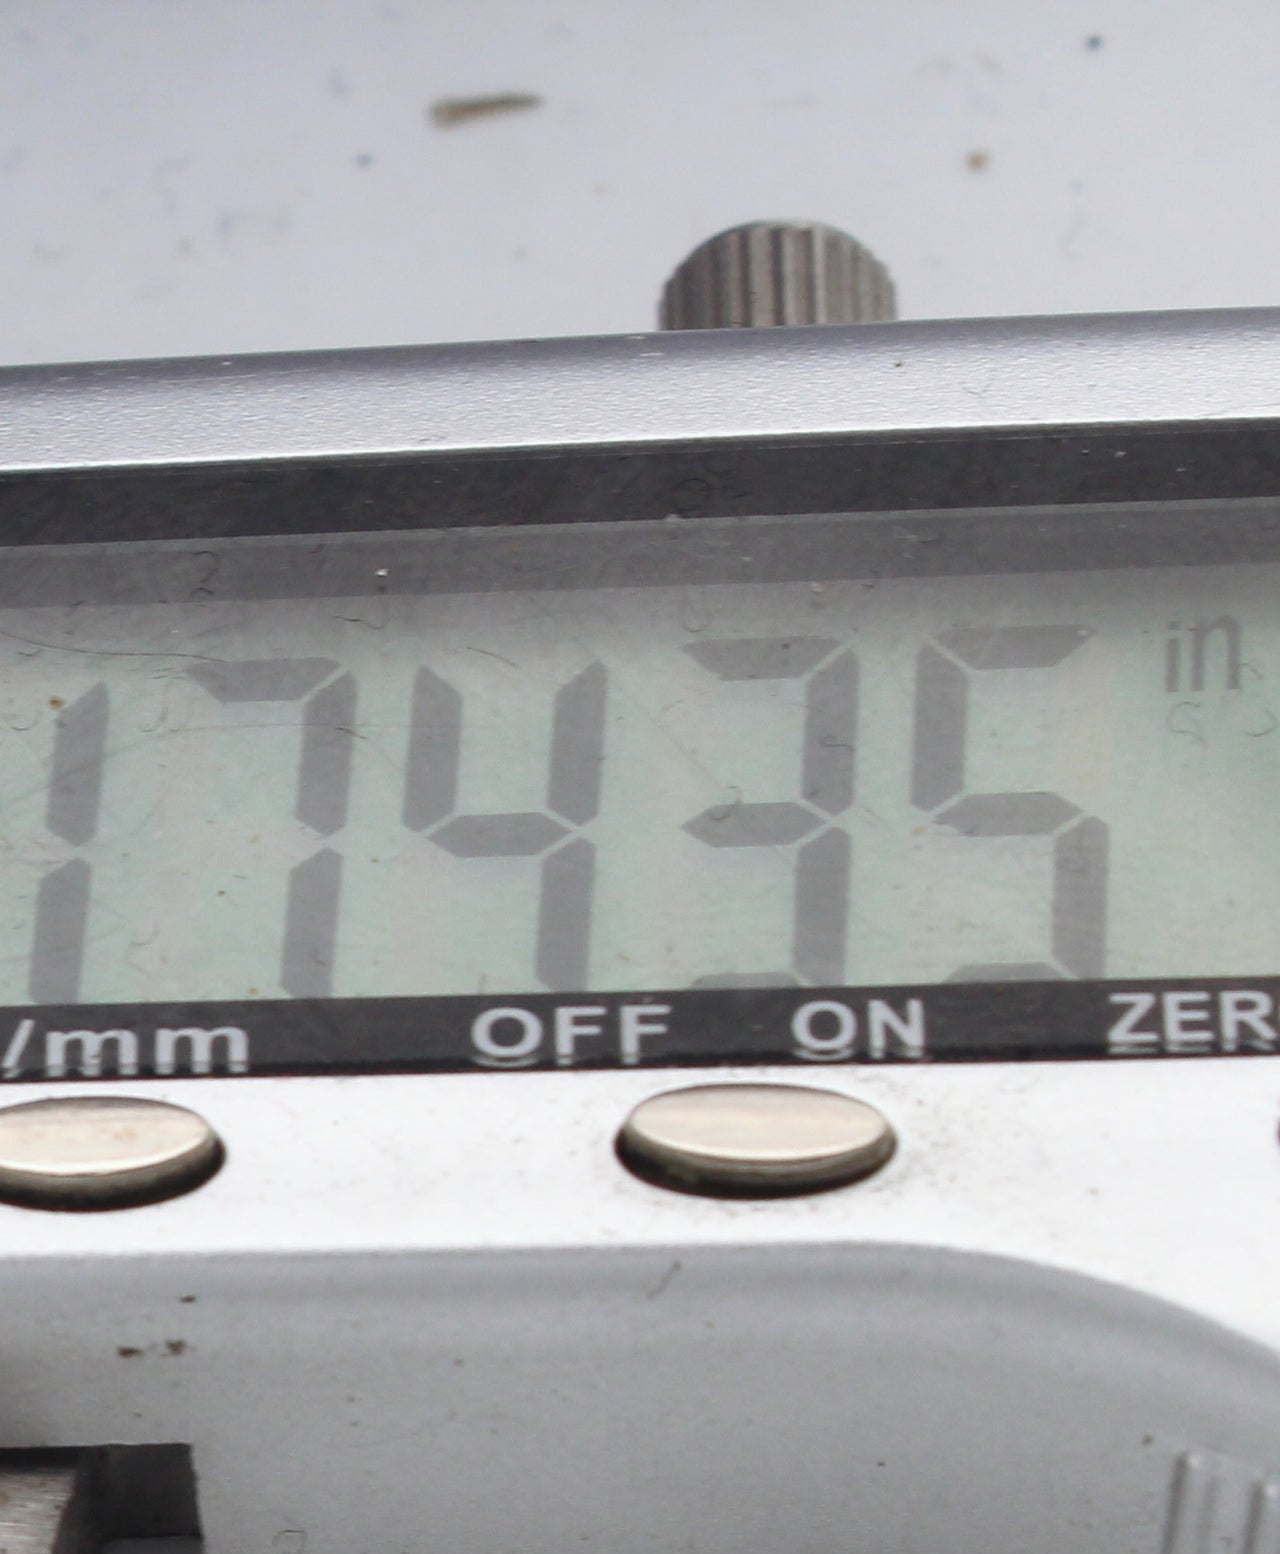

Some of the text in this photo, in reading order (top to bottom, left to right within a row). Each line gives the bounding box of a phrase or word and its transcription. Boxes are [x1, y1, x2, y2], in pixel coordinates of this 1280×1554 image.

[1165, 615, 1241, 693] in
[470, 1002, 674, 1061] OFF
[790, 997, 927, 1056] ON
[1106, 990, 1280, 1050] ZER
